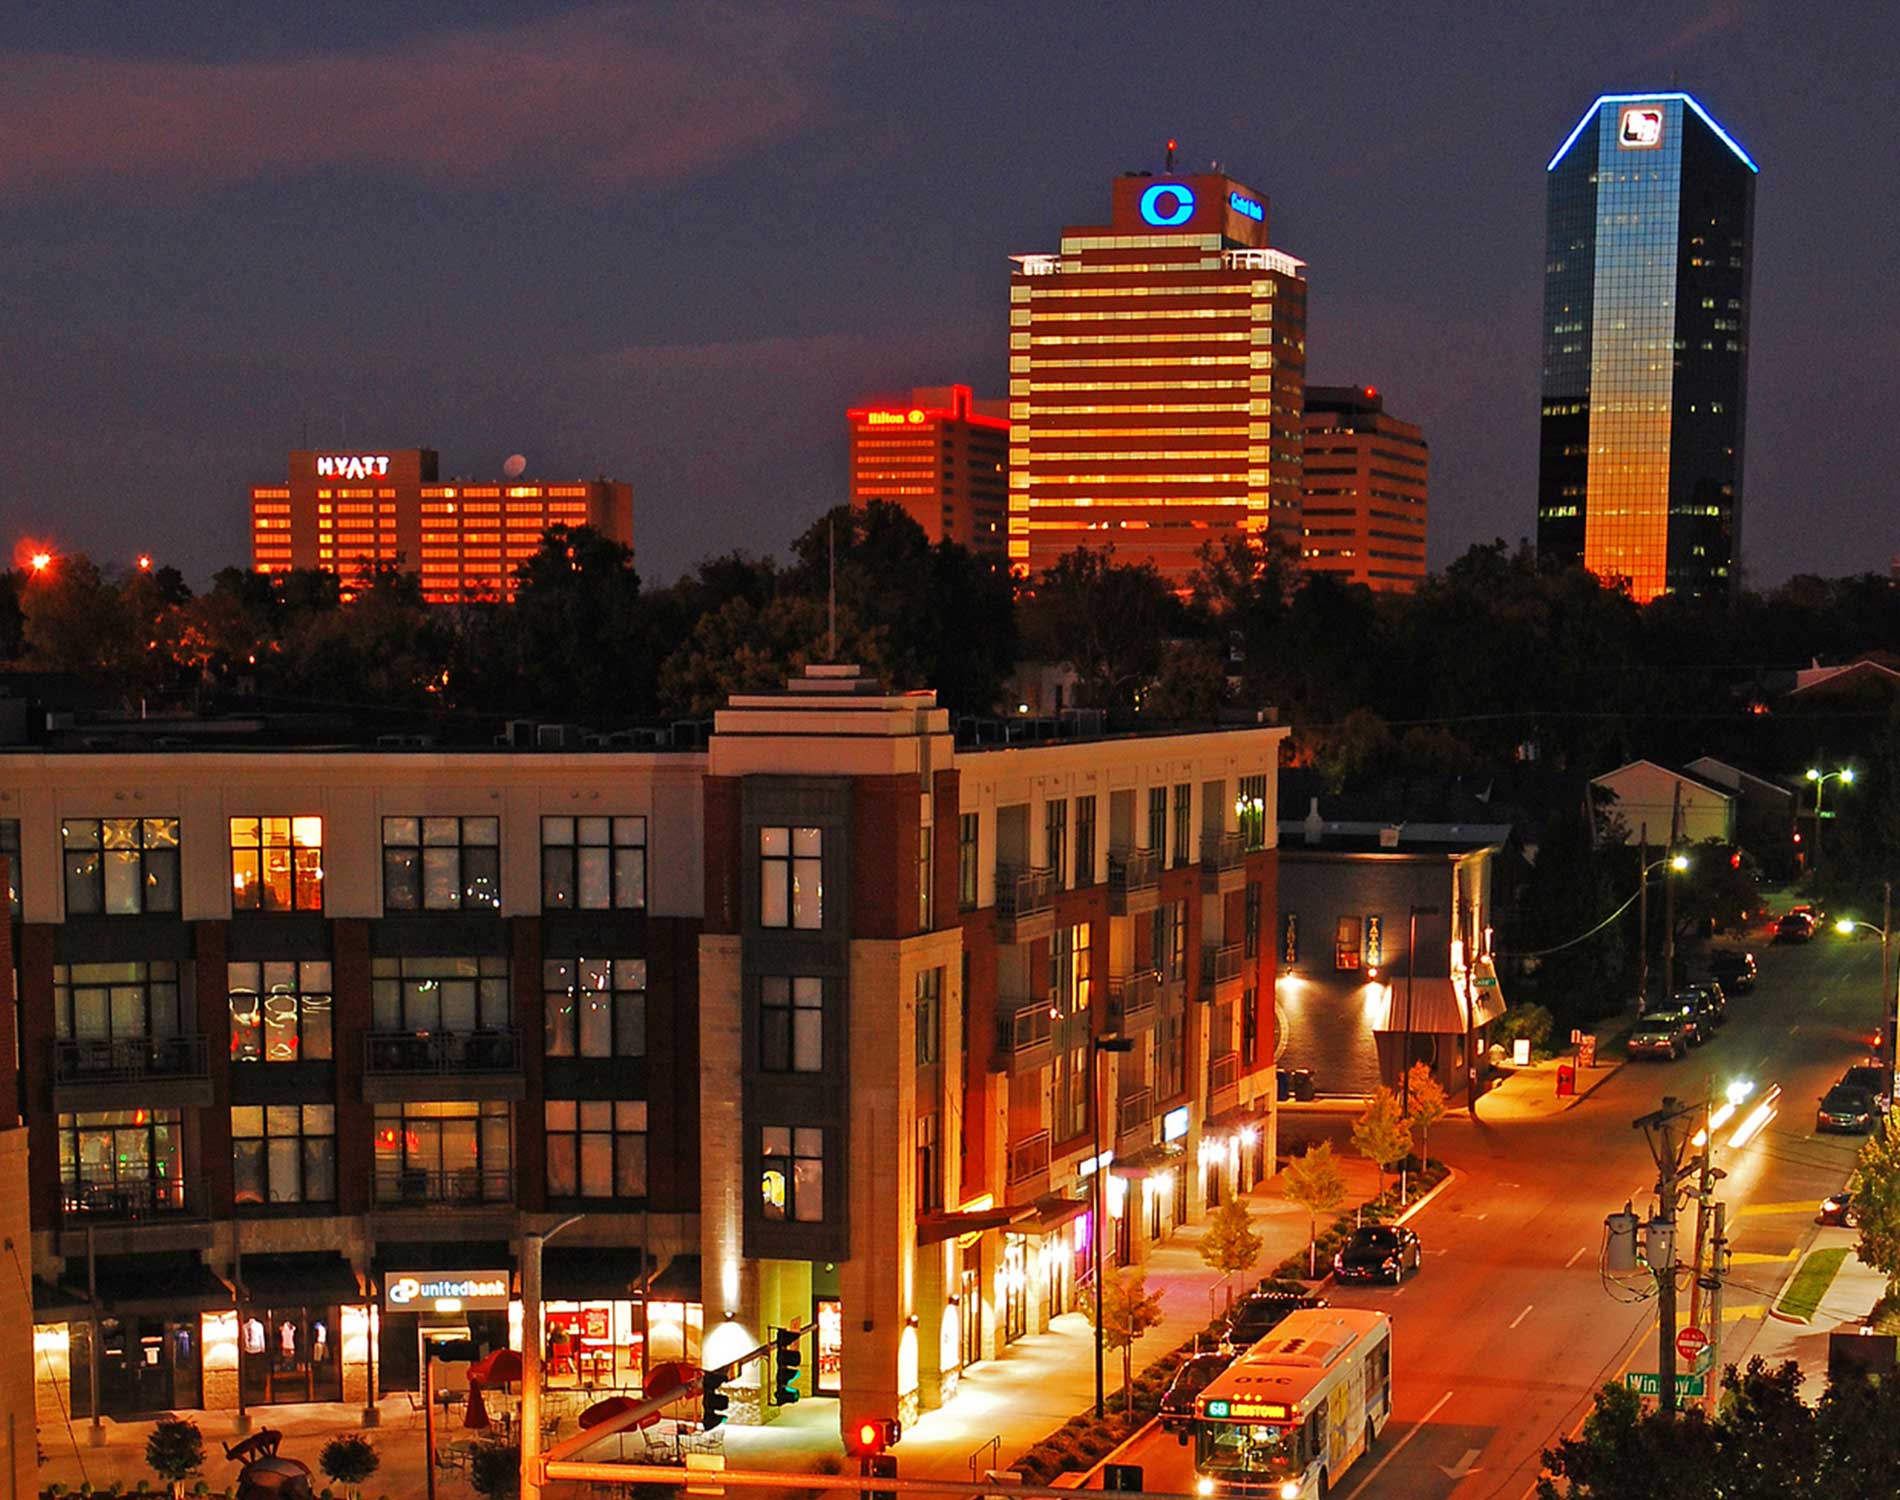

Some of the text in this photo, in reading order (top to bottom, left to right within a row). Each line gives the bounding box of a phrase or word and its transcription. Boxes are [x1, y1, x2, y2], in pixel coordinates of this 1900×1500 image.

[868, 411, 905, 425] Hilton
[317, 456, 390, 480] HYATT
[1367, 917, 1379, 966] TATTOO
[420, 1279, 506, 1297] unitedbank
